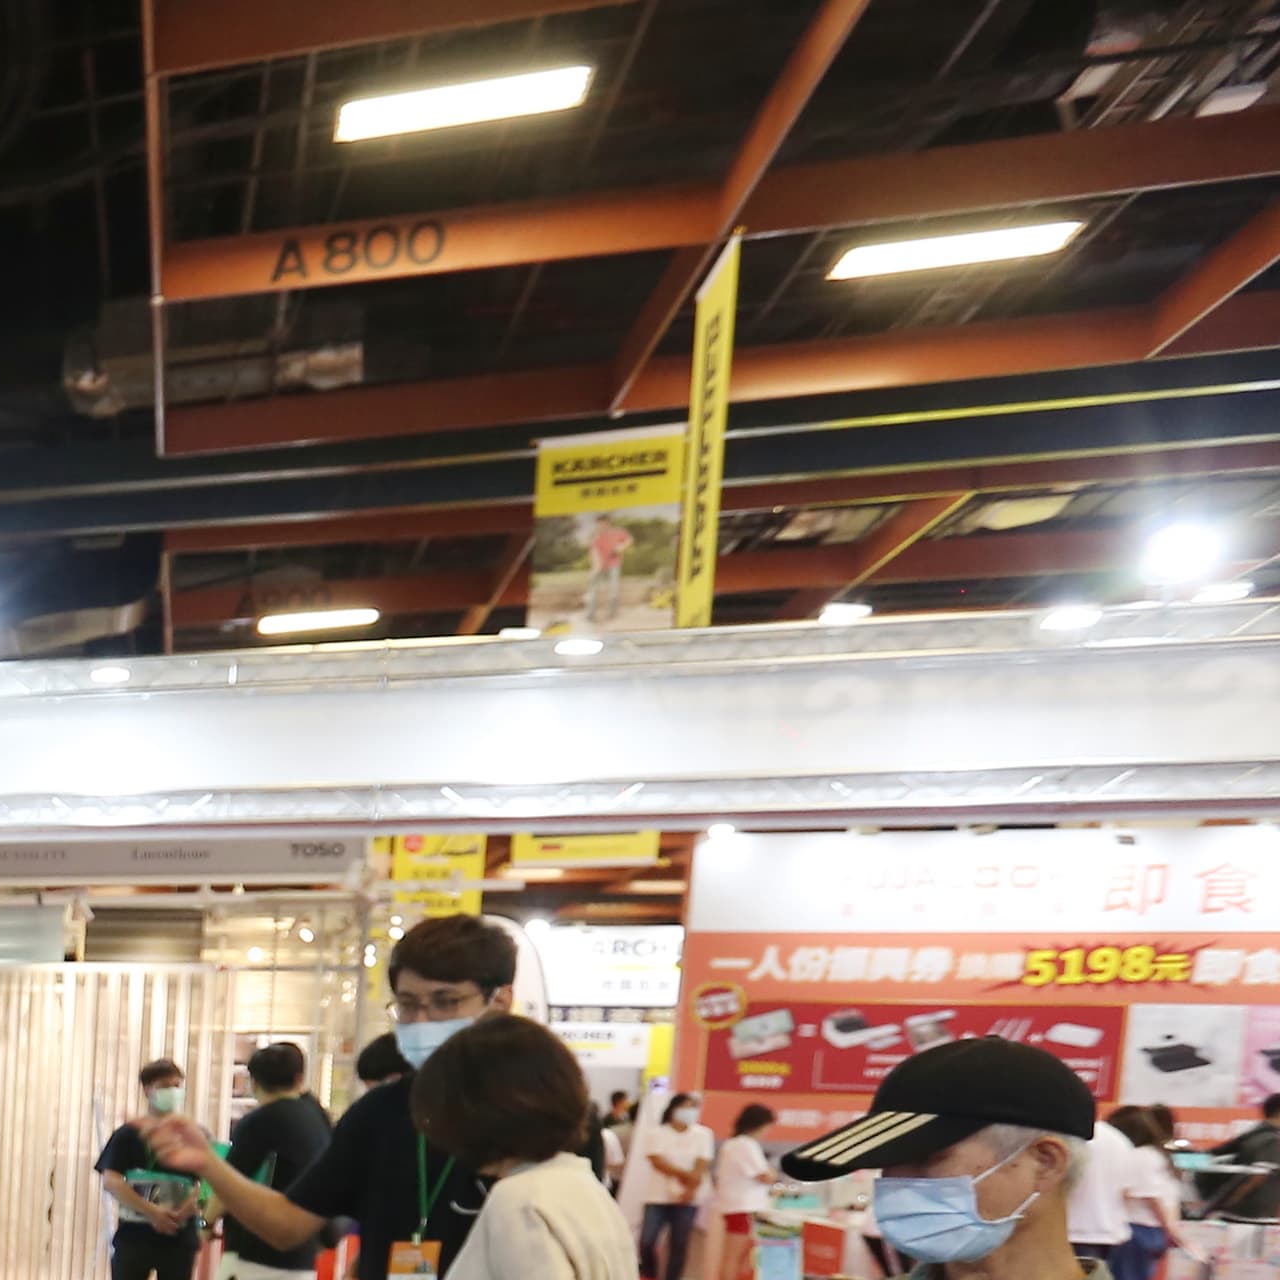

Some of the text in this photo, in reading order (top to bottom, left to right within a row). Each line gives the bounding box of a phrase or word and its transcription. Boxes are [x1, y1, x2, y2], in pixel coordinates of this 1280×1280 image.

[270, 220, 447, 282] A 800
[290, 842, 346, 858] TOSO
